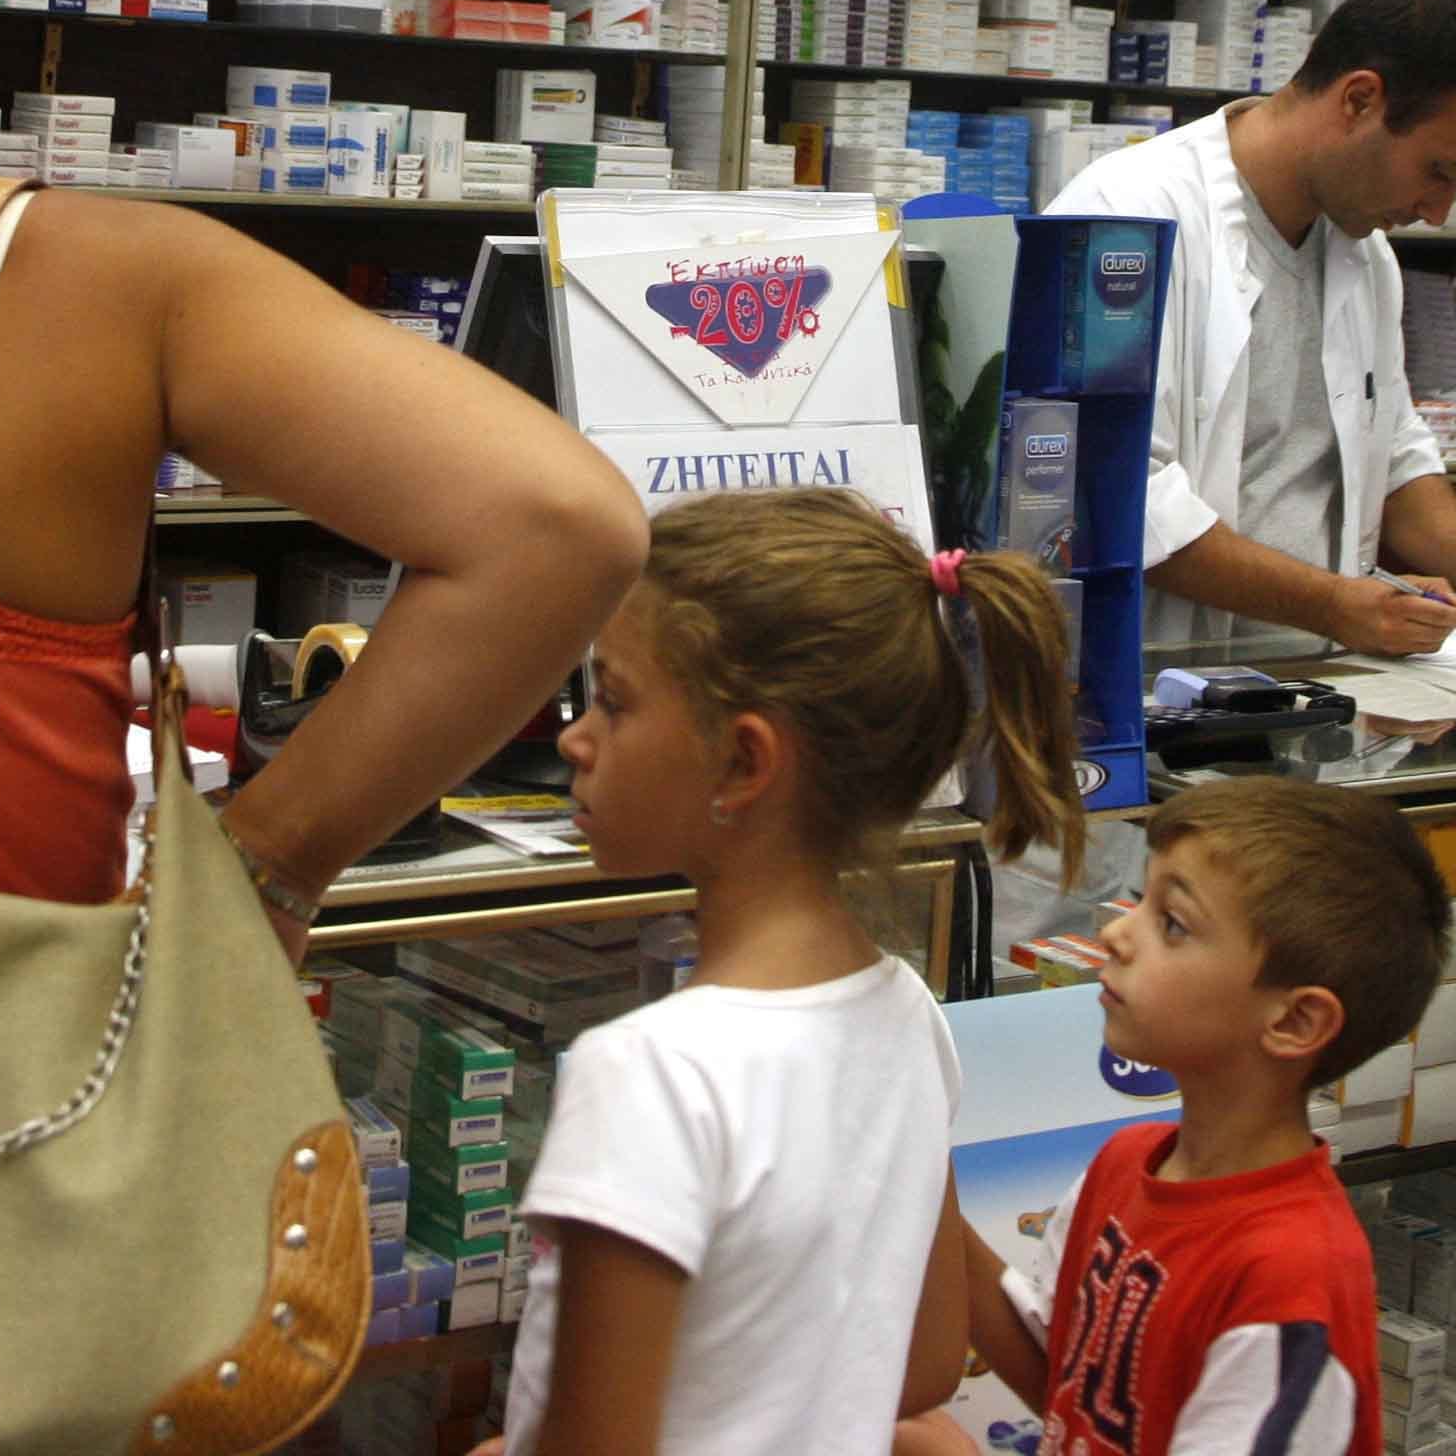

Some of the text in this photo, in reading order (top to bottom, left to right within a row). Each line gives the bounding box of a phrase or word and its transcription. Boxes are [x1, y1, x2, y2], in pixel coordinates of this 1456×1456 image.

[1104, 253, 1143, 271] durex
[1028, 439, 1065, 455] durex
[646, 449, 852, 494] ΖΗΤΕΙΤΑΙ
